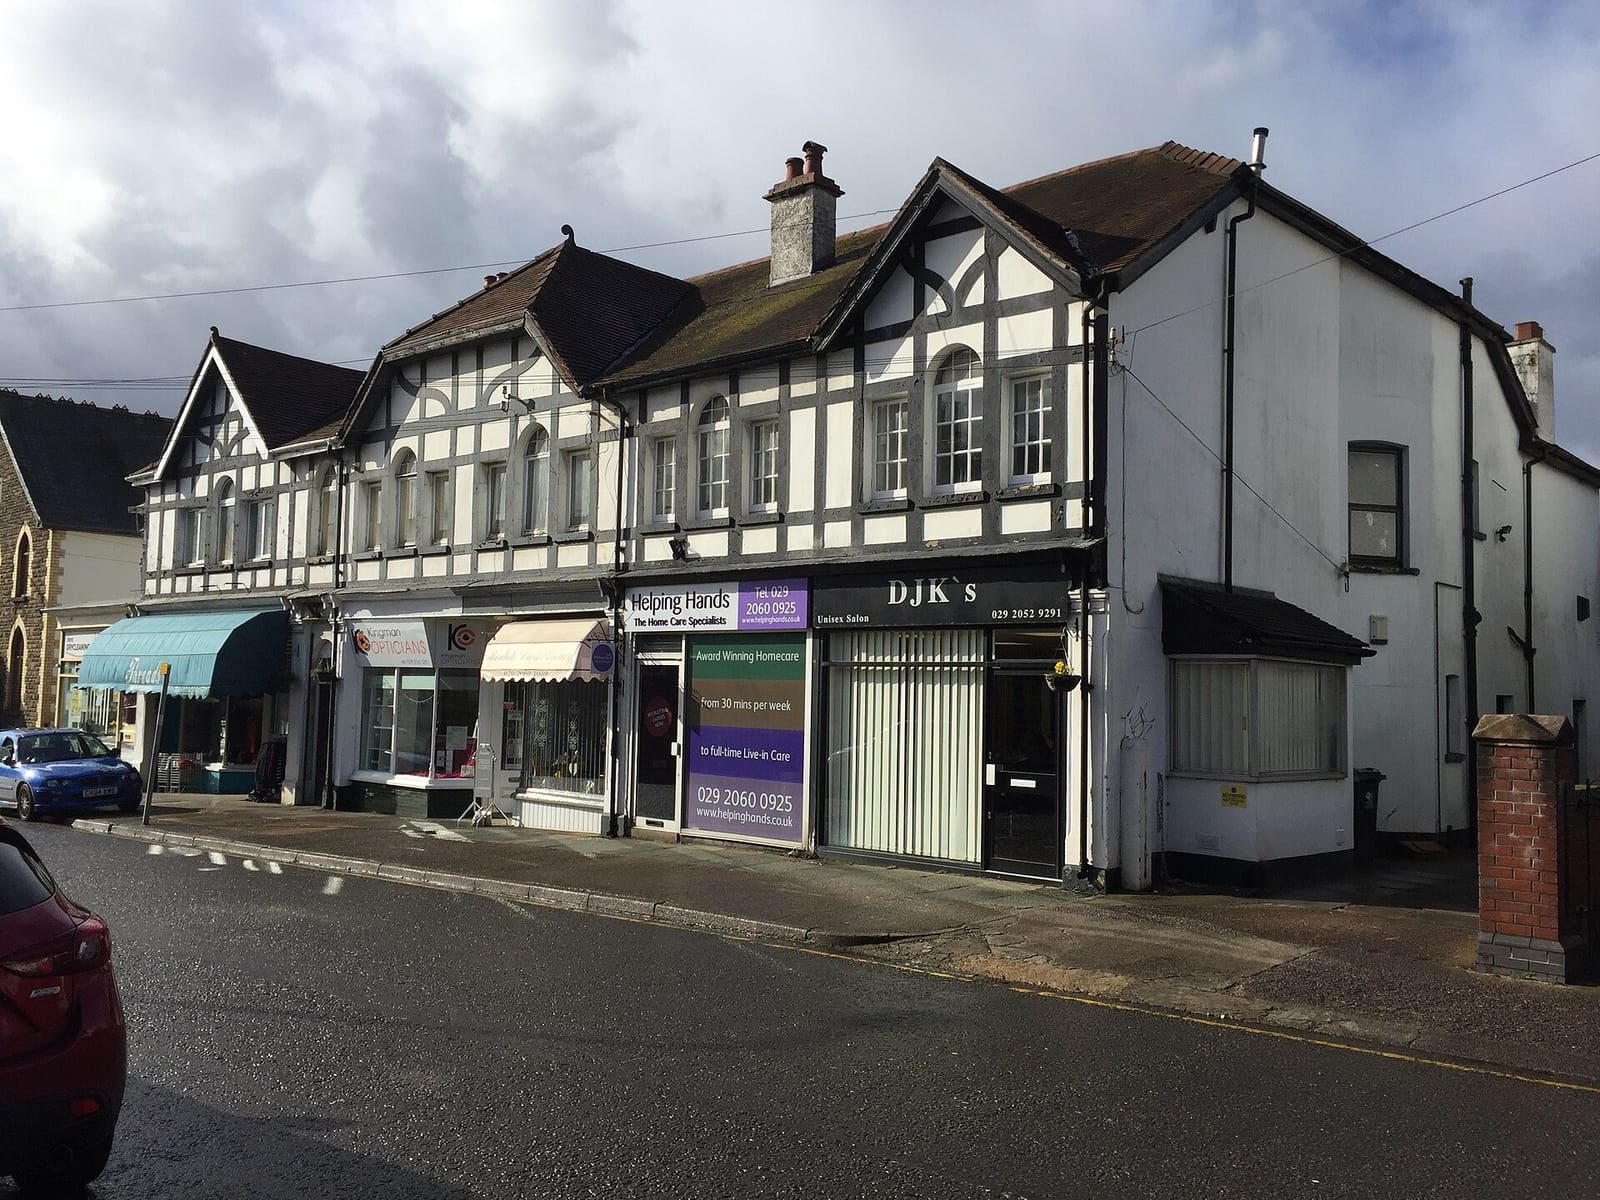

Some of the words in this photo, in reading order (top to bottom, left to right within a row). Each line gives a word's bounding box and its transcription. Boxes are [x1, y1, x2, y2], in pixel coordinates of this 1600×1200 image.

[771, 585, 789, 597] 029
[632, 592, 681, 615] Helping
[685, 588, 730, 609] Hands
[746, 603, 770, 615] 2060
[772, 601, 796, 614] 0925
[742, 615, 801, 625] www.helpinghands.co.uk
[817, 615, 844, 624] Unisex
[846, 614, 869, 623] Salon
[991, 609, 1008, 619] 029
[1012, 608, 1034, 619] 2052
[1038, 608, 1062, 618] 9291
[634, 618, 646, 627] The
[648, 617, 668, 627] Home
[670, 617, 687, 626] Care
[688, 616, 727, 628] Specialists
[367, 628, 401, 640] Kingman
[370, 640, 427, 655] OPTICIANS
[696, 651, 721, 661] Award
[722, 651, 754, 663] Winning
[756, 651, 799, 661] Homecare
[701, 697, 720, 708] from
[721, 698, 732, 709] 30
[733, 699, 752, 710] mins
[754, 700, 768, 712] per
[769, 700, 791, 711] week
[701, 745, 709, 756] to
[711, 745, 741, 758] full-time
[743, 748, 769, 760] Live-in
[771, 750, 791, 762] Care
[697, 786, 720, 803] 029
[724, 789, 756, 808] 2060
[760, 793, 793, 812] 0925
[696, 807, 793, 827] www.helpinghands.co.uk
